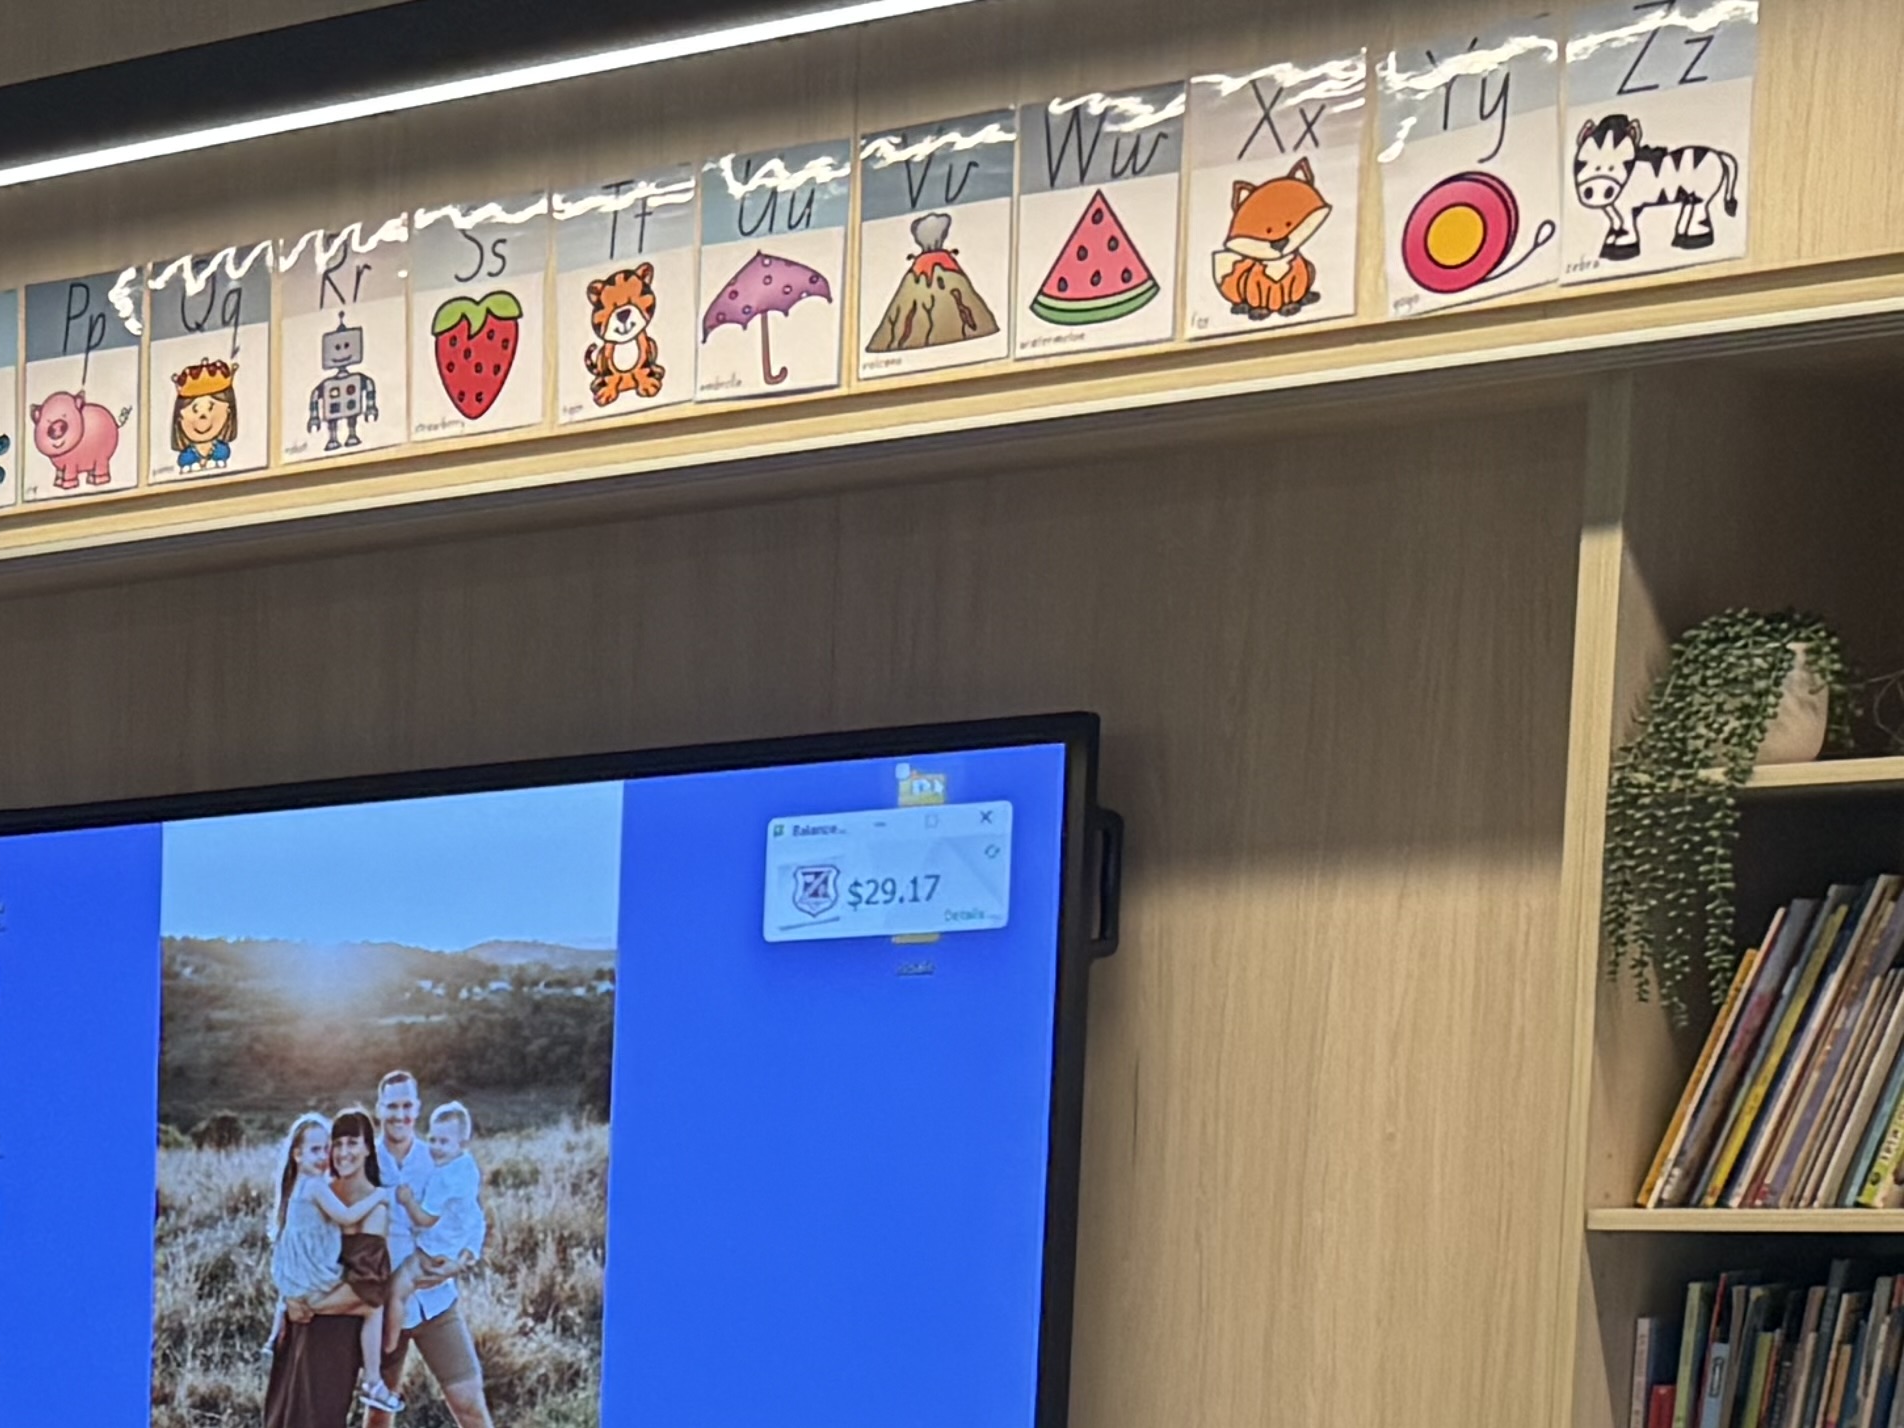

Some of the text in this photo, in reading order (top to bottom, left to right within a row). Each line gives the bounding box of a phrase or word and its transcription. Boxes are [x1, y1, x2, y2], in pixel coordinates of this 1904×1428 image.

[1617, 0, 1714, 95] Zz
[1238, 80, 1326, 160] Xx
[1426, 37, 1510, 163] Yy
[904, 129, 979, 208] Vv
[1045, 104, 1168, 188] Ww
[738, 158, 815, 237] Uu
[181, 258, 242, 358] Qq
[320, 233, 372, 309] Rr
[63, 282, 106, 385] Pp
[847, 874, 941, 911] $29.17
